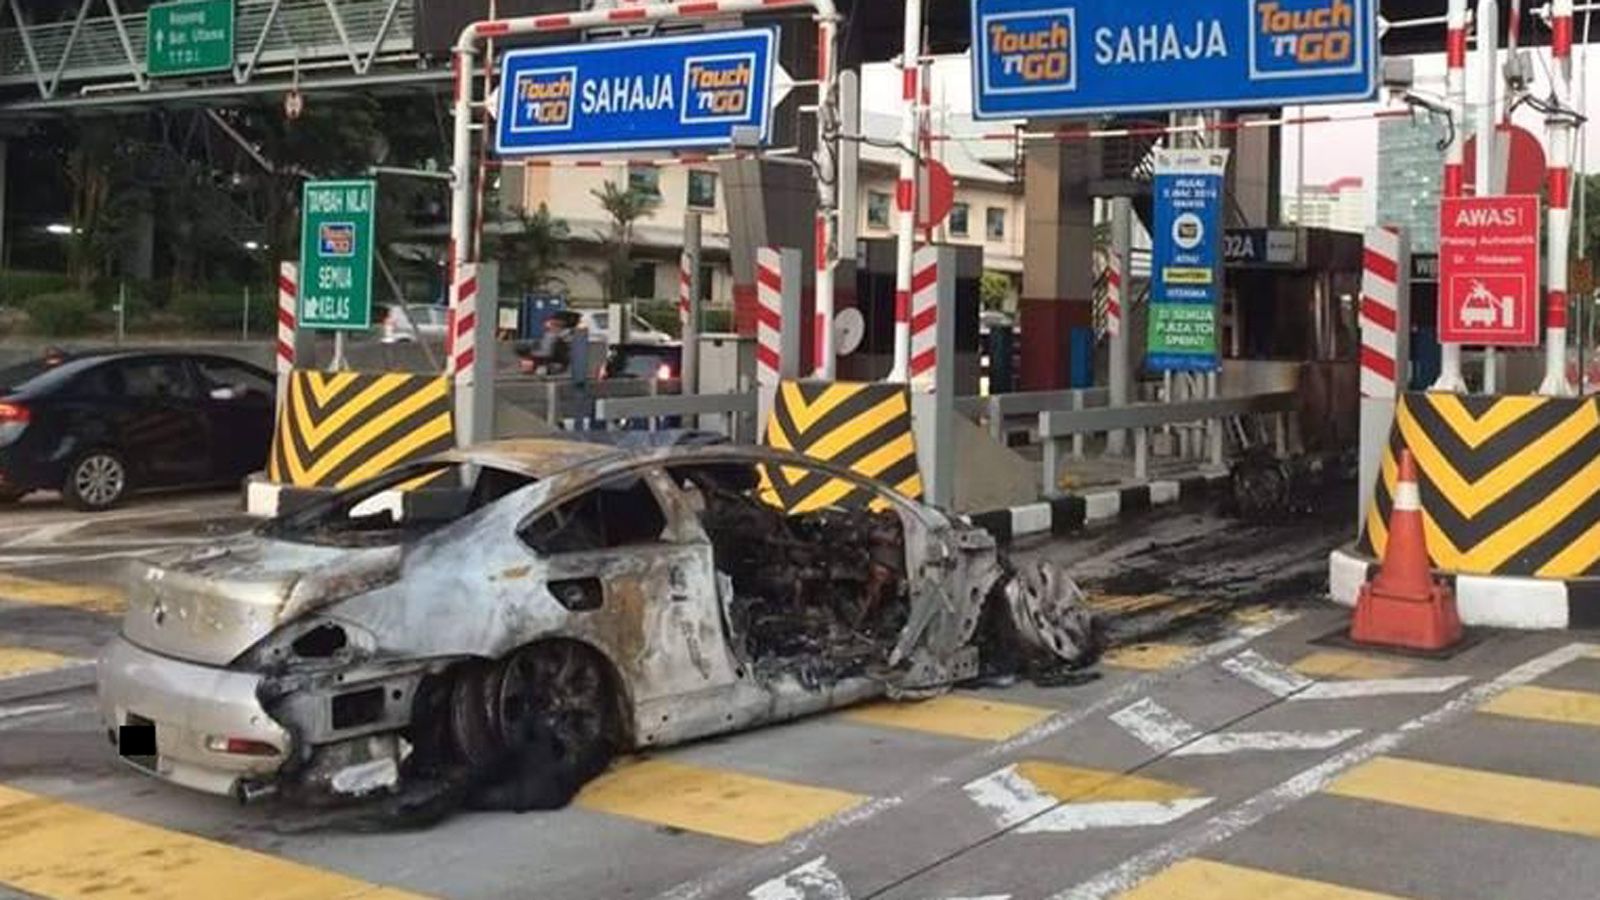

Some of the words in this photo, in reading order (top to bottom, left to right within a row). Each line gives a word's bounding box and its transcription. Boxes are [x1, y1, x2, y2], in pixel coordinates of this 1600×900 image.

[1257, 0, 1353, 33] Touch
[989, 21, 1068, 54] Touch
[1094, 20, 1228, 65] SAHAJA
[519, 76, 571, 98] Touch
[690, 62, 749, 88] Touch
[580, 74, 675, 114] SAHAJA
[319, 266, 351, 289] SEMUA
